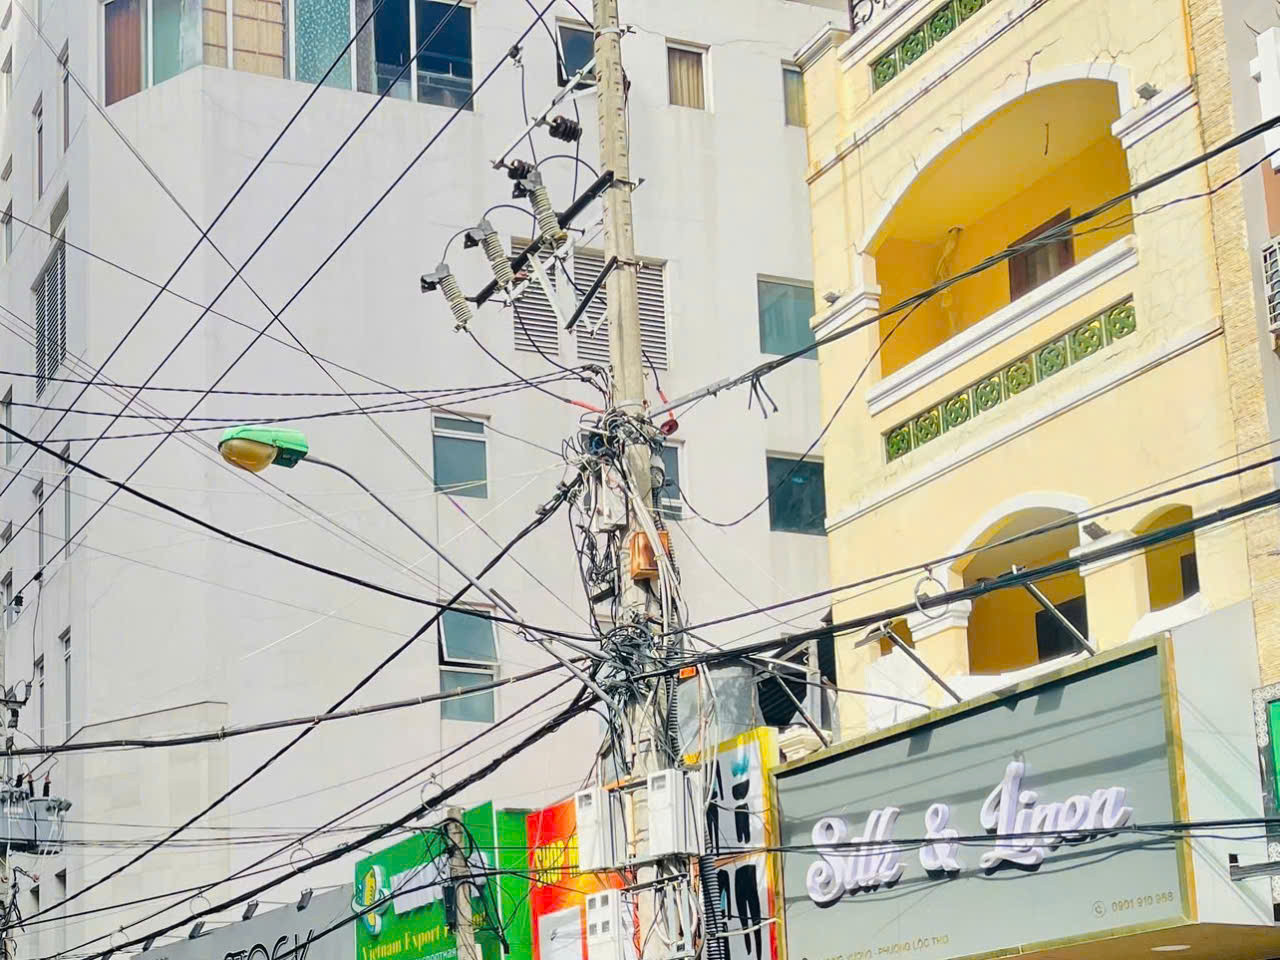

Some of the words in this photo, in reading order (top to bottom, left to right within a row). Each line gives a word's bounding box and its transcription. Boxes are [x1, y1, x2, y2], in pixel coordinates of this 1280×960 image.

[807, 807, 904, 903] Silk
[920, 804, 960, 871] &
[980, 761, 1133, 868] Linen
[362, 940, 402, 960] Vietnam
[405, 925, 440, 951] Export
